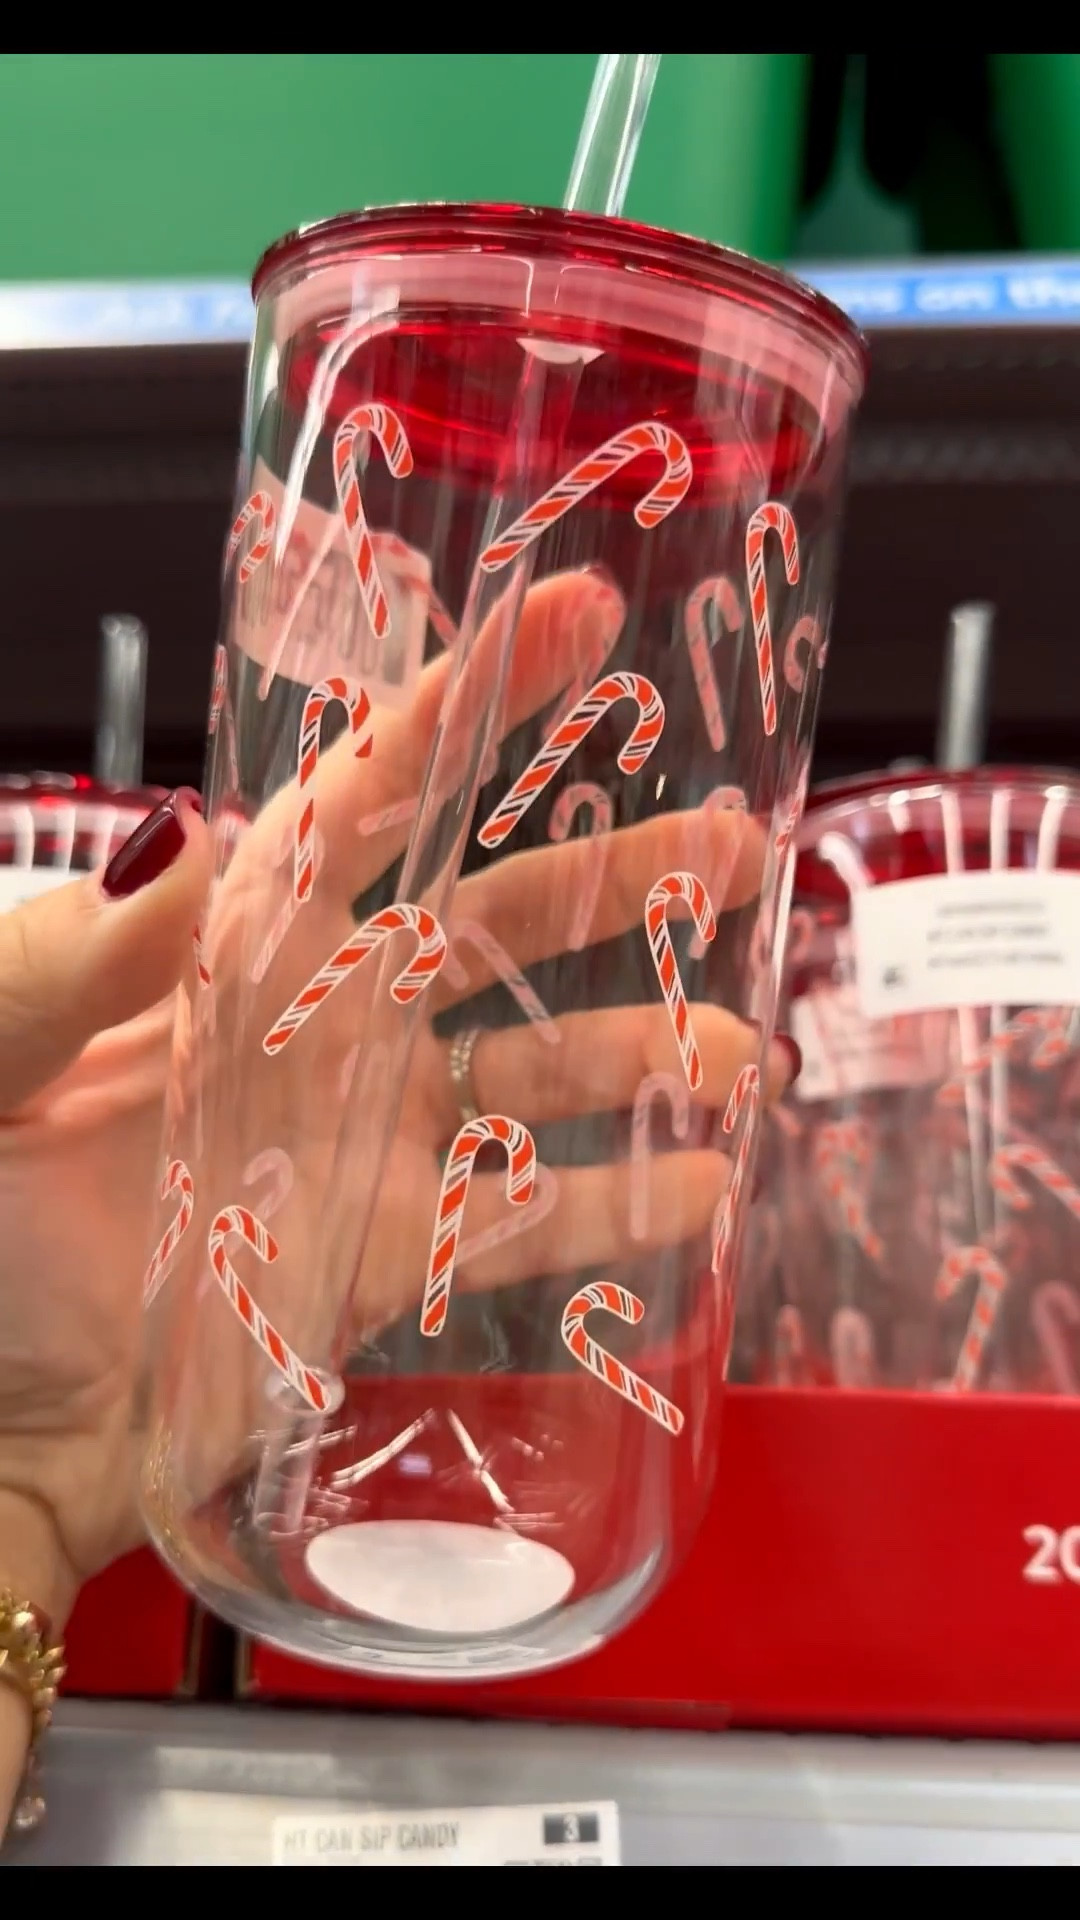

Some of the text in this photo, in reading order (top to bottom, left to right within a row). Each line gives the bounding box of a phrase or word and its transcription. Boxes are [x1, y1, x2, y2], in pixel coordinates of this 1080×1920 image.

[317, 1827, 353, 1852] CAN
[360, 1824, 391, 1851] SIP
[398, 1821, 460, 1851] CANDY
